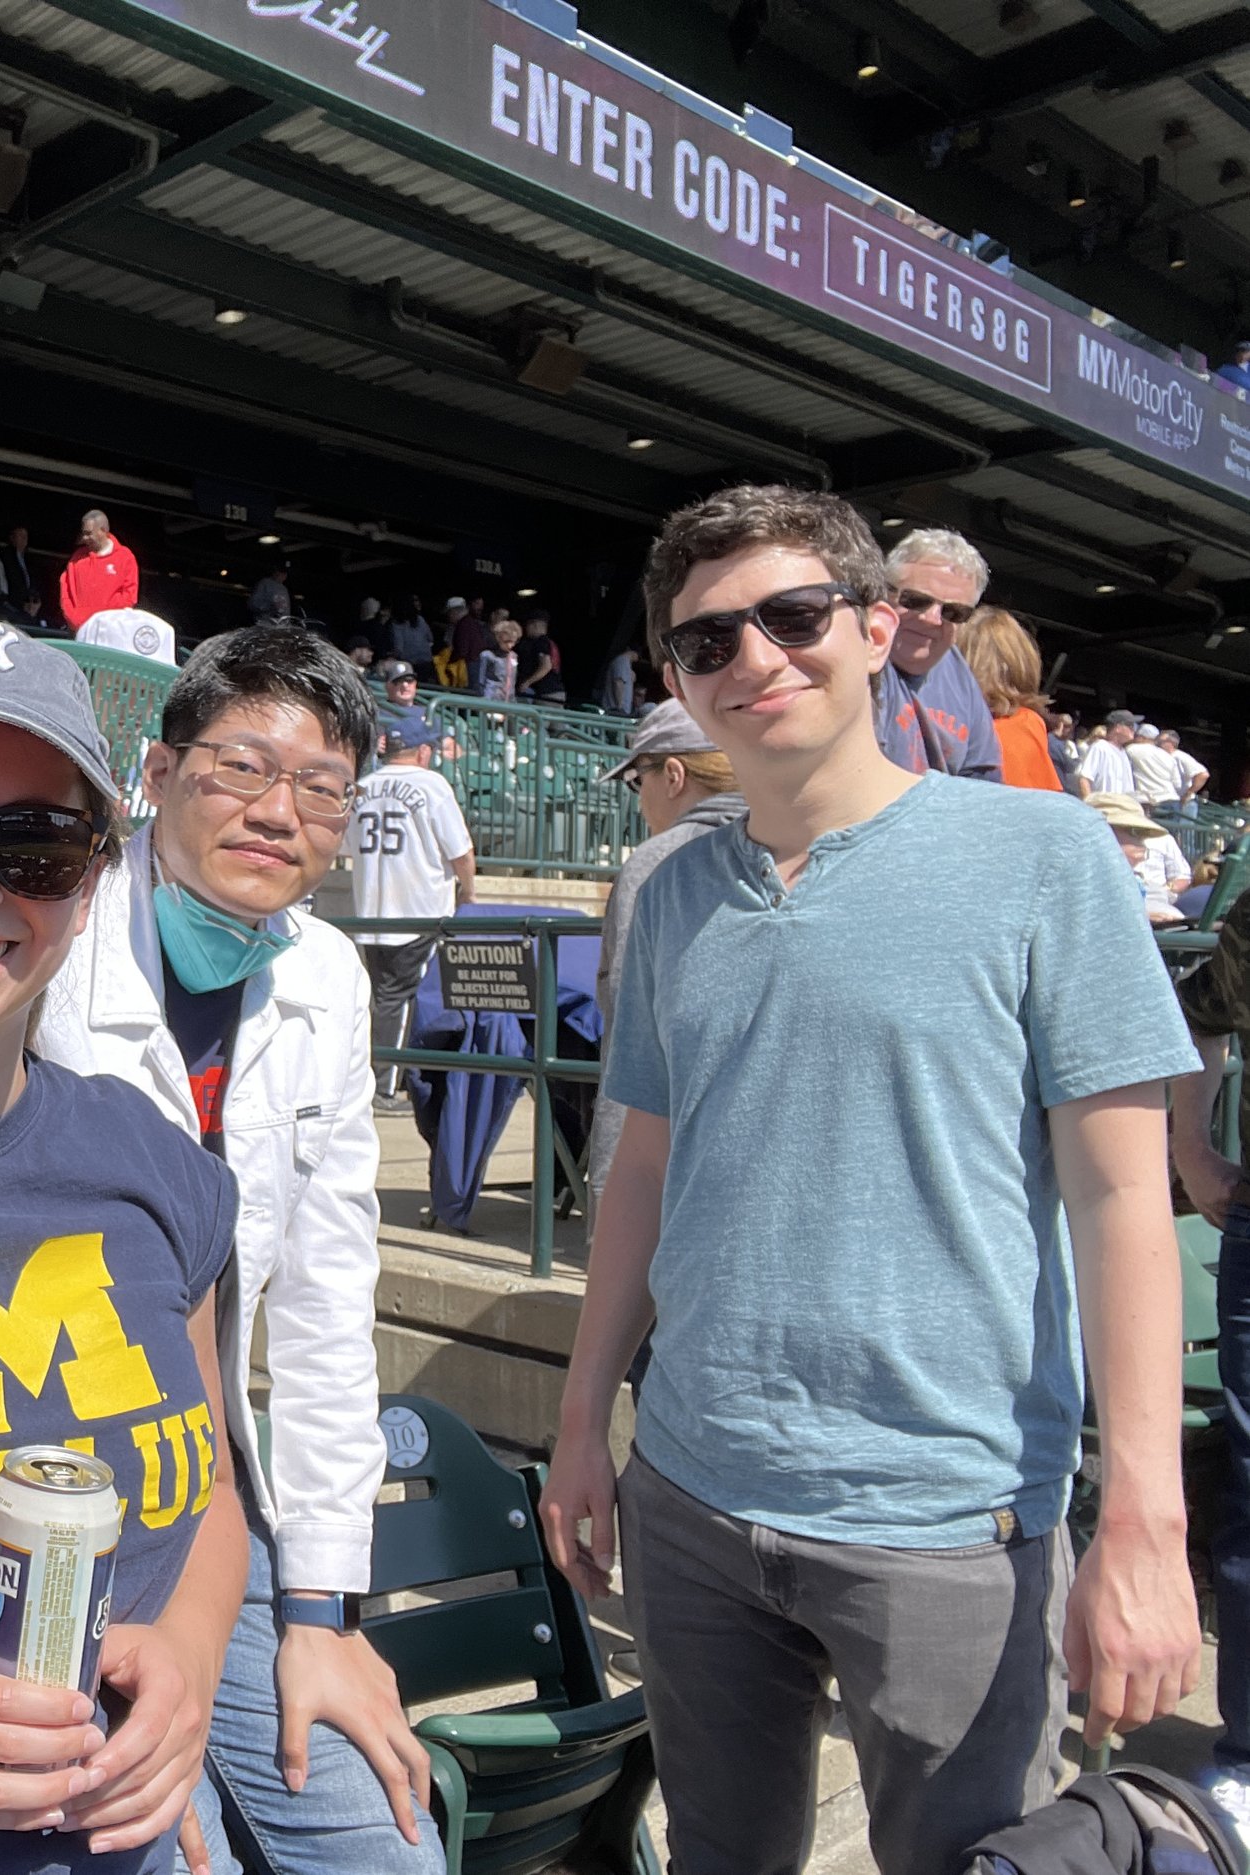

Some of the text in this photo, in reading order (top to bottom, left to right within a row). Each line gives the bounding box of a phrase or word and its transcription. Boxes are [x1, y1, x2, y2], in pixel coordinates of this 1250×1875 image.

[490, 44, 802, 268] ENTER CODE:
[1136, 414, 1172, 447] MOBILE
[357, 811, 407, 855] 35
[446, 944, 525, 966] CAUTION!
[456, 969, 519, 983] BE ALERT FOR
[450, 982, 528, 997] OBJECTS LEAVING
[450, 996, 531, 1011] THE PLAYING FIELD
[391, 1425, 415, 1450] 10
